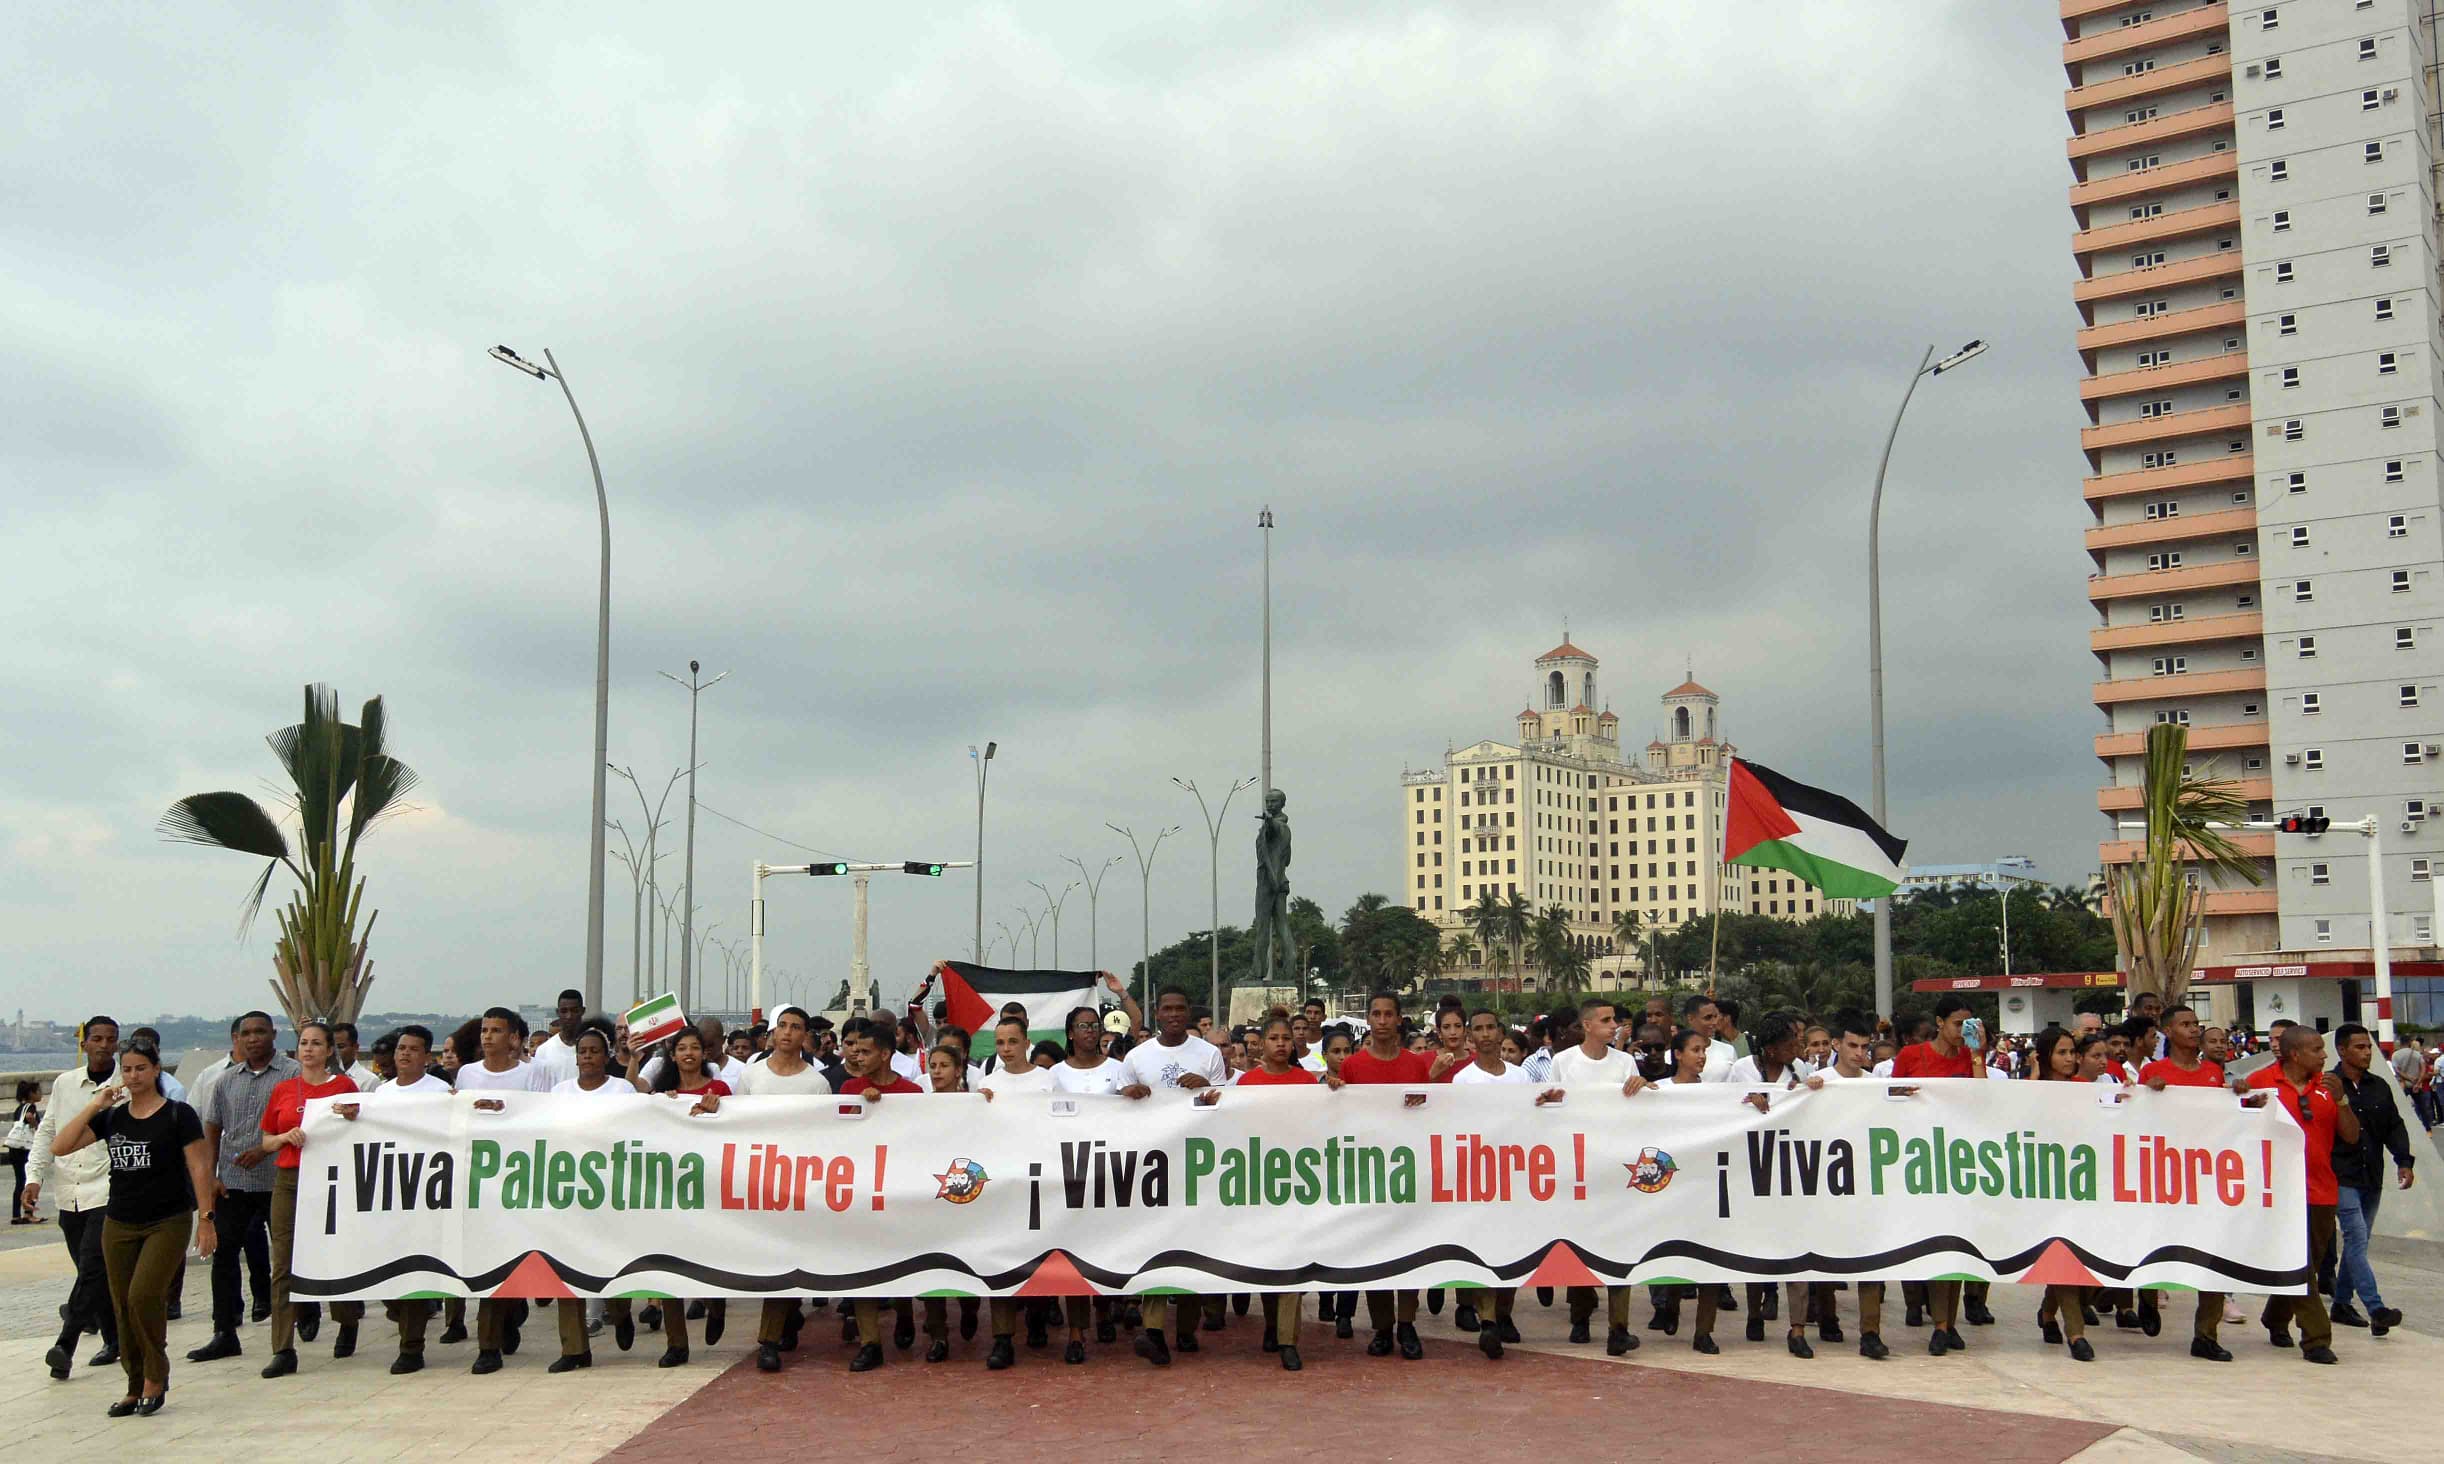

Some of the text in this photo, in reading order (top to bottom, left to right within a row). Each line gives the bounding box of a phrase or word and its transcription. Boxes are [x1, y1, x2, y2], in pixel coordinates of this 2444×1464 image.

[110, 1144, 150, 1158] FIDEL
[113, 1157, 128, 1168] EN
[468, 1140, 705, 1211] Palestina
[1185, 1136, 1416, 1206] Palestina
[1870, 1127, 2097, 1201] Palestina
